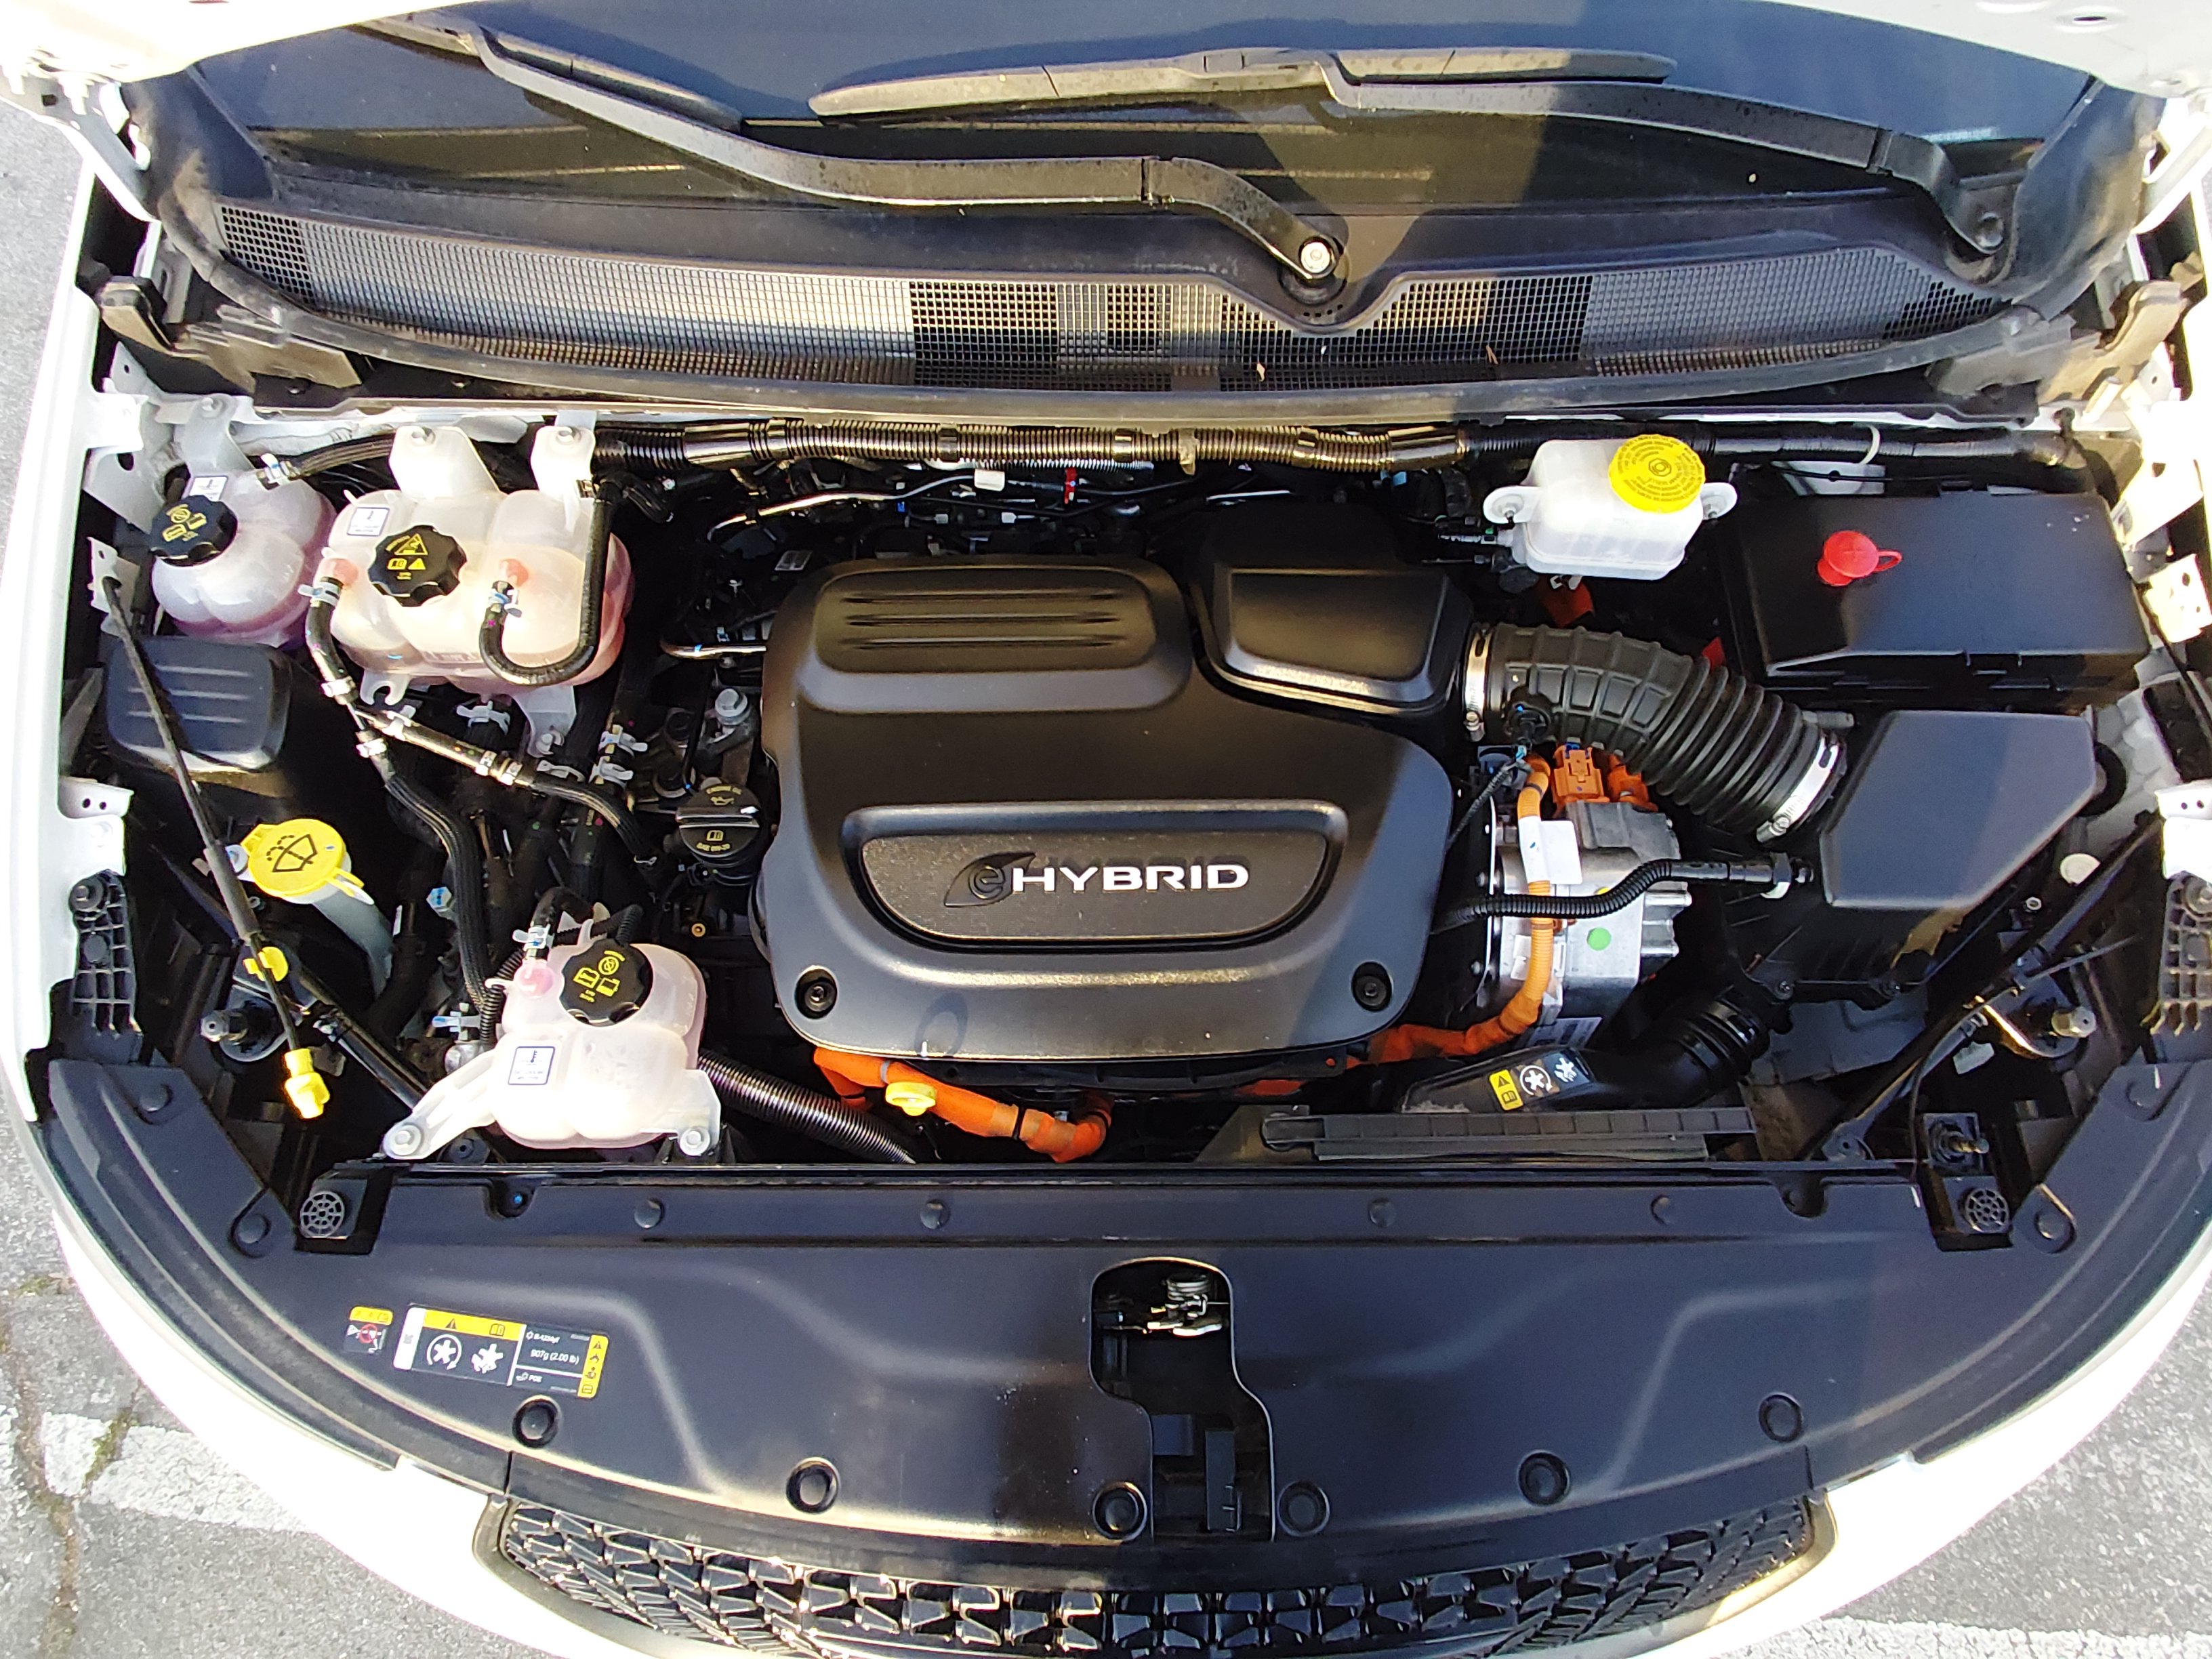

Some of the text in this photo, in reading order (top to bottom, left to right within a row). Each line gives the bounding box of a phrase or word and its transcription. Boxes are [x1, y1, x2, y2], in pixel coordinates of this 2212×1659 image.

[531, 1349, 579, 1365] 907g (2.00 lb)
